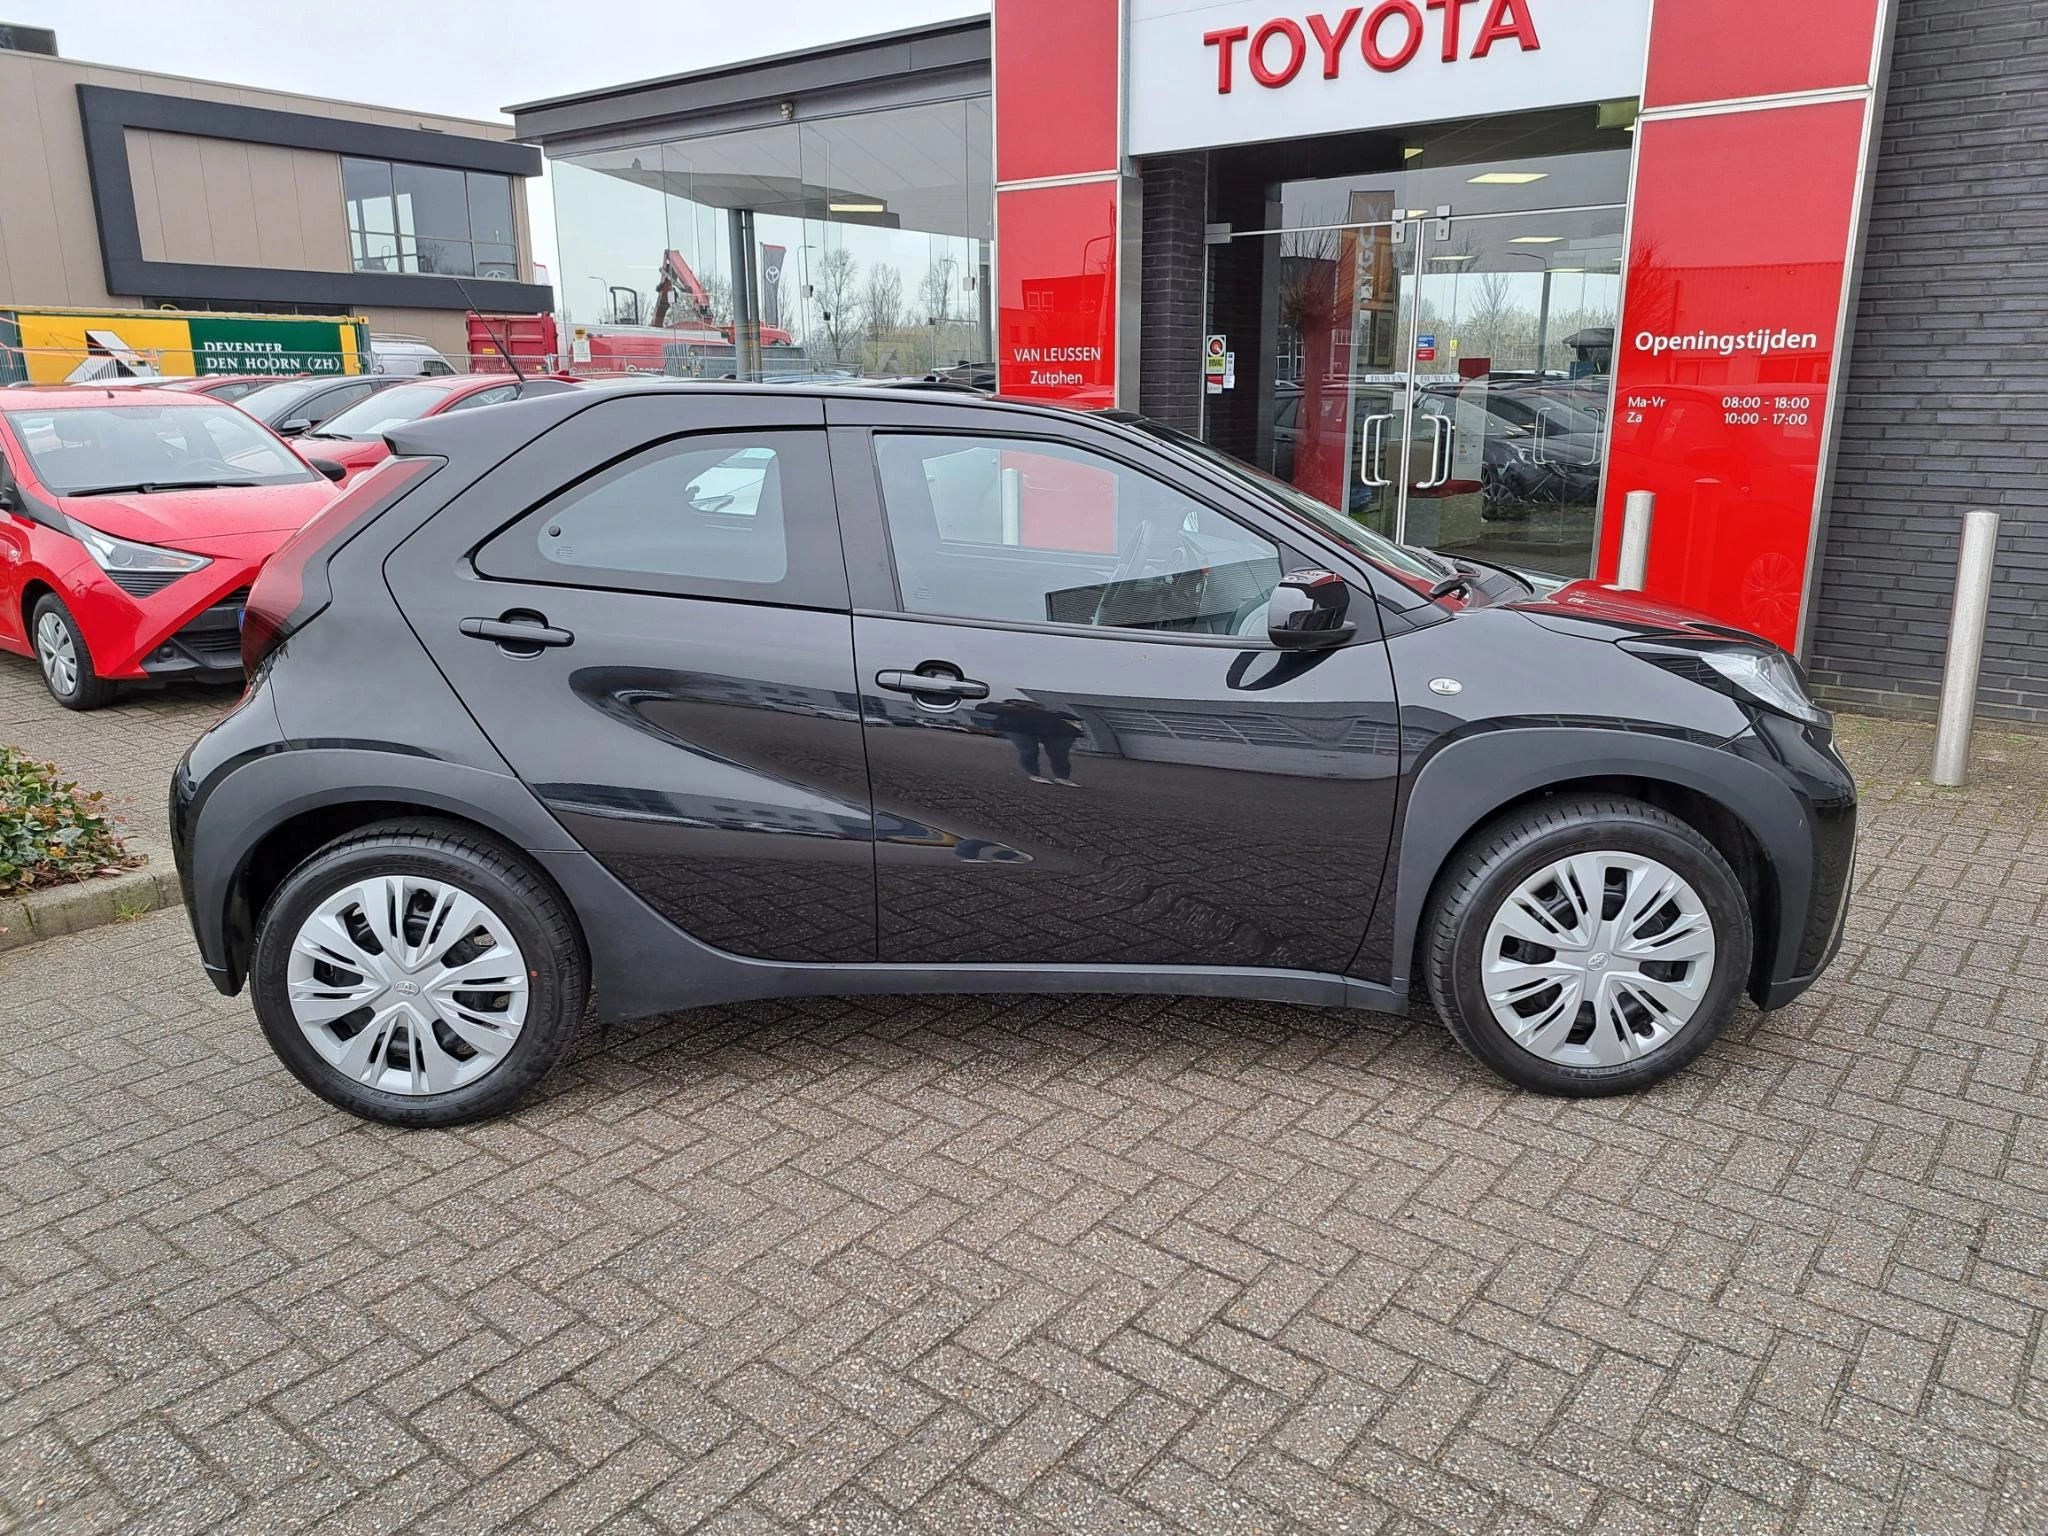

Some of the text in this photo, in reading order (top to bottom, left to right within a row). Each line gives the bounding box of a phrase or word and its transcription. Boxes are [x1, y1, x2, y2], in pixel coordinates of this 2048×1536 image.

[1203, 0, 1541, 94] TOYOTA
[203, 341, 283, 353] DEVENTER
[1635, 328, 1817, 355] Openingstijden
[1014, 346, 1101, 362] VAN LEUSSEN
[206, 356, 340, 371] DEN HOORN (ZH)
[1030, 370, 1083, 387] Zutphen
[1627, 396, 1666, 408] Ma-Vr
[1721, 396, 1761, 409] 08:00
[1774, 396, 1810, 409] 18:00
[1626, 412, 1643, 423] Za
[1724, 412, 1759, 425] 10:00
[1772, 413, 1808, 425] 17:00
